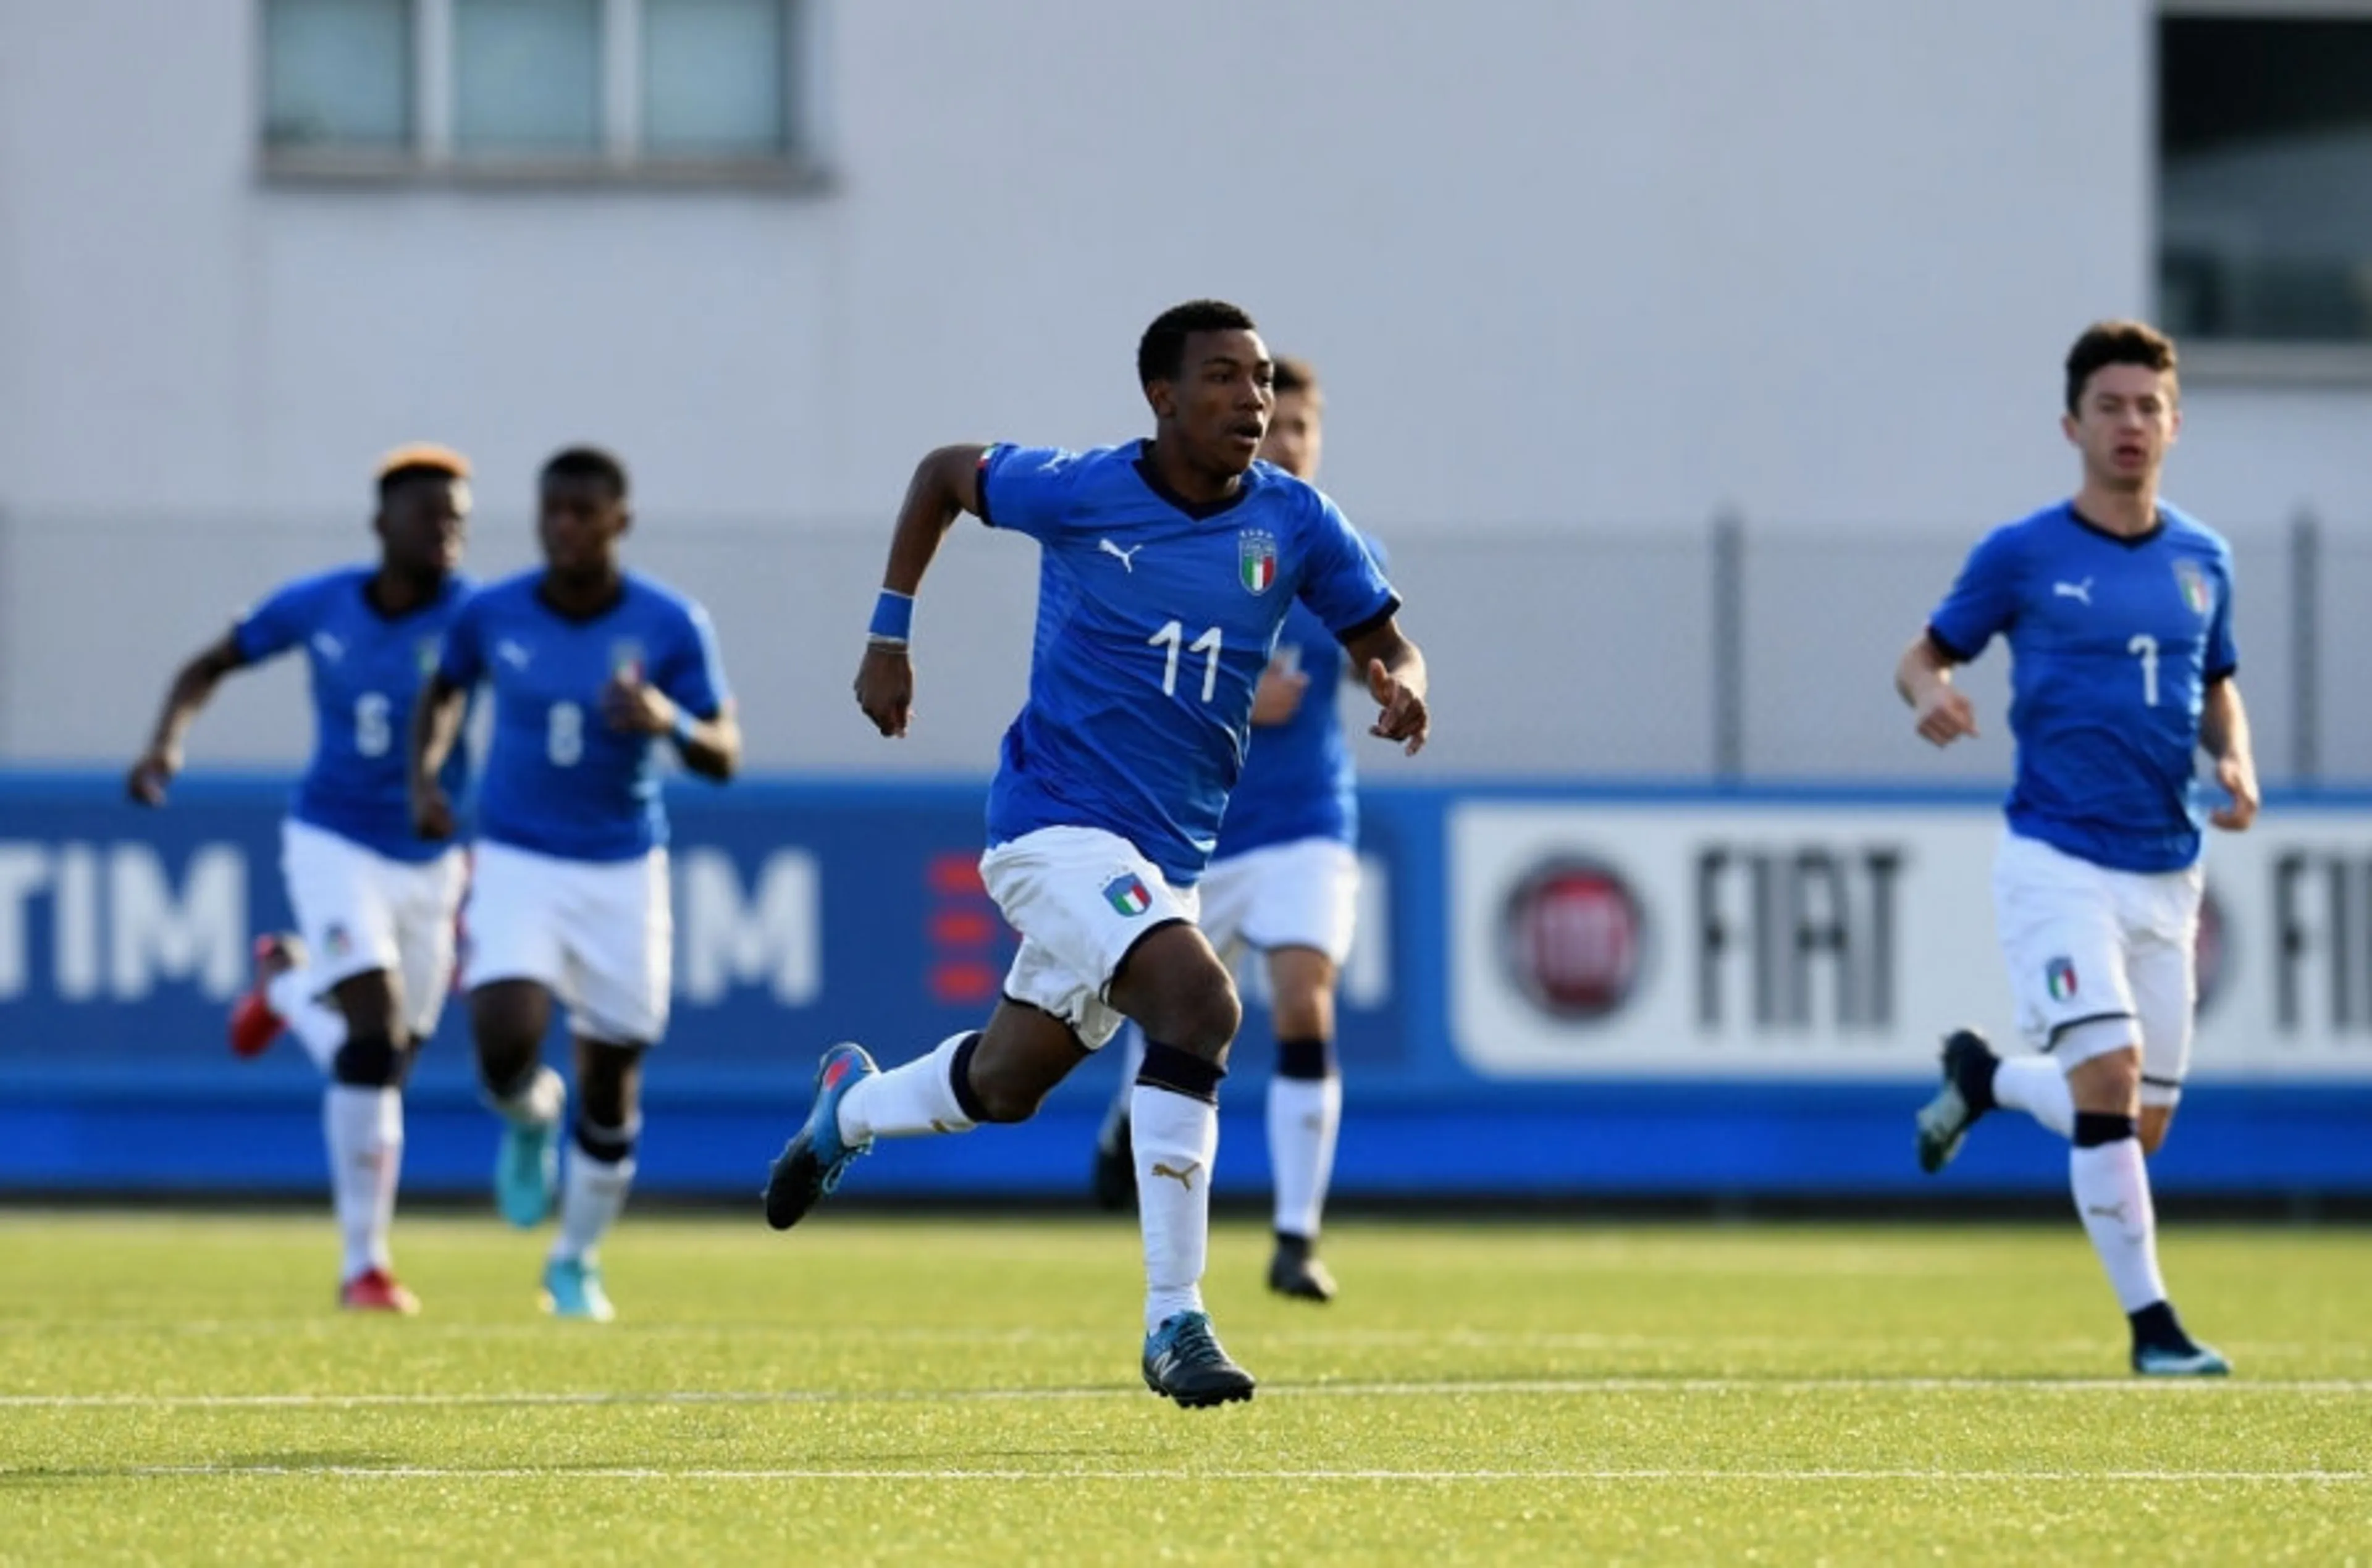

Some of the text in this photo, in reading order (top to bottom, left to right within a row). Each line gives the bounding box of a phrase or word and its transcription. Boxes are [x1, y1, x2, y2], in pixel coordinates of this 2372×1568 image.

[1147, 619, 1222, 703] 11
[0, 843, 242, 1000] TIM
[1691, 842, 1909, 1033] FIAT
[2269, 847, 2372, 1034] FI
